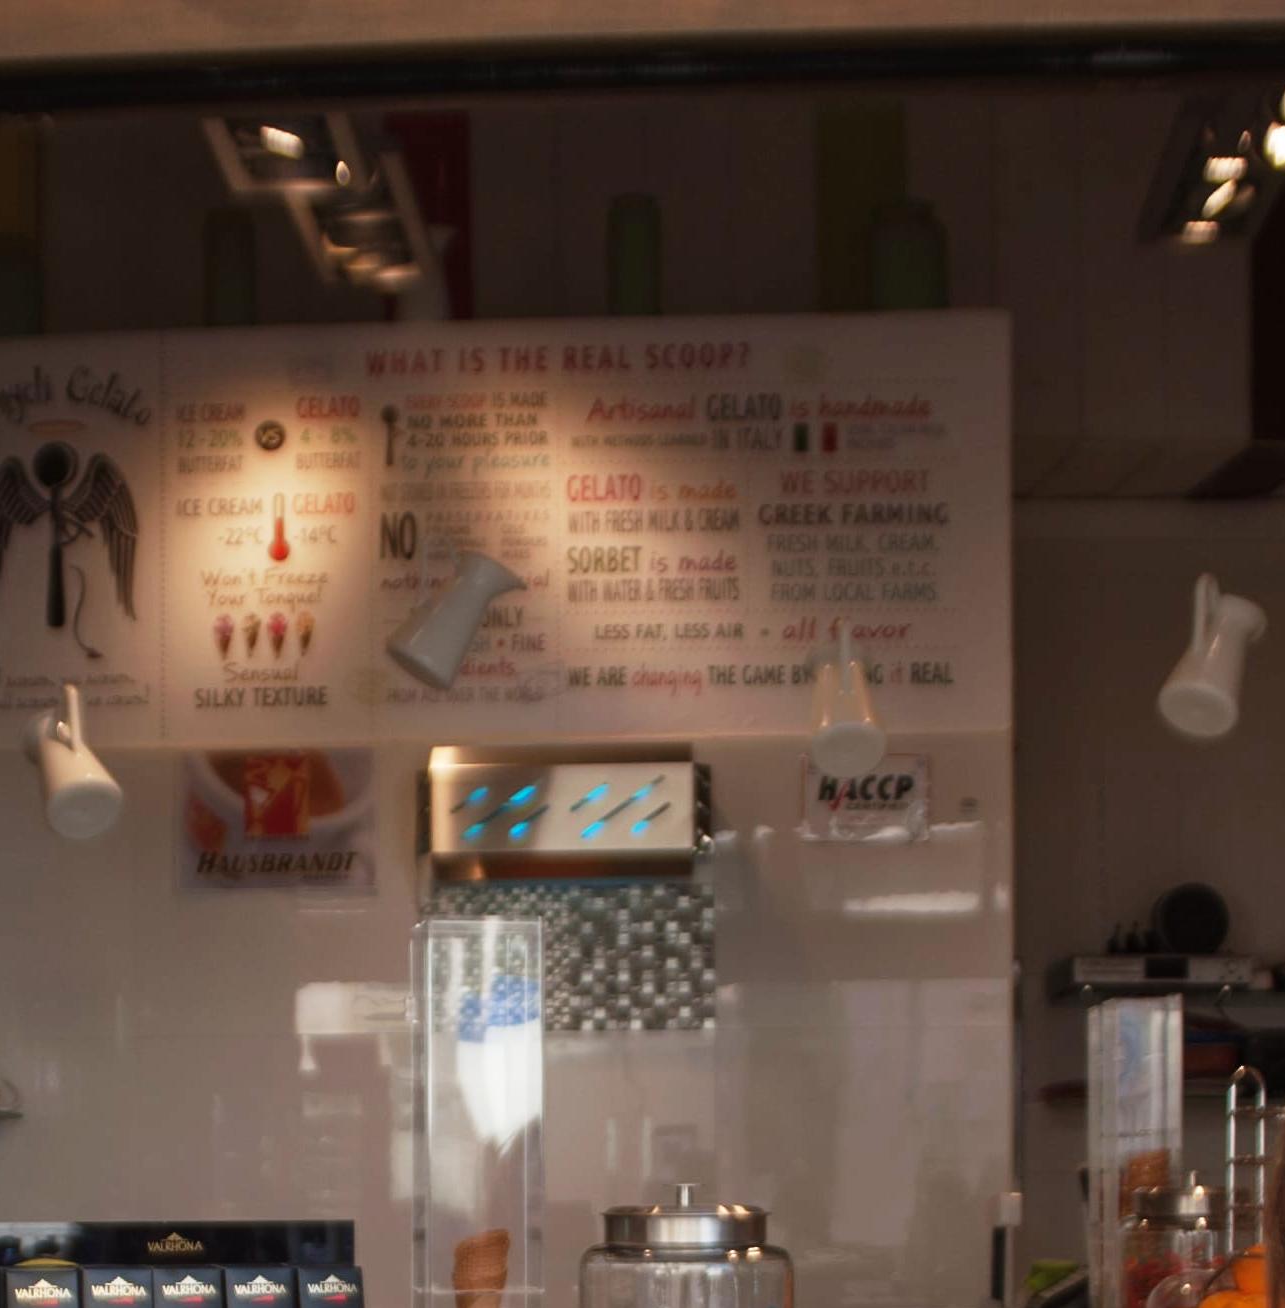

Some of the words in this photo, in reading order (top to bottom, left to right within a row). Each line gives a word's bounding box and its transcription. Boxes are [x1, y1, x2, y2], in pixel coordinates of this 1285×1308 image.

[365, 348, 445, 376] WHAT
[458, 347, 485, 373] IS
[499, 346, 549, 372] THE
[561, 344, 632, 372] REAL
[644, 341, 752, 369] SCOOP?
[296, 395, 361, 418] GELATO
[510, 390, 548, 406] MADE
[587, 395, 696, 421] Artisanal
[706, 393, 783, 421] GELATO
[789, 400, 810, 418] is
[818, 393, 933, 418] handmade
[176, 403, 198, 423] ICE
[202, 402, 245, 422] CREAM
[407, 414, 432, 429] NO
[440, 413, 487, 429] MORE
[495, 413, 537, 427] THAN
[406, 432, 444, 448] 4-20
[451, 431, 498, 447] HOURS
[504, 430, 548, 445] PRIOR
[711, 427, 729, 449] IN
[736, 426, 784, 450] ITALY
[178, 454, 244, 474] BUTTERFAT
[296, 450, 361, 470] BUTTERFAT
[423, 454, 465, 479] your
[471, 450, 551, 476] pleasure
[567, 472, 642, 501] GELATO
[650, 483, 669, 500] is
[678, 480, 738, 500] made
[780, 468, 815, 494] WE
[823, 468, 930, 494] SUPPORT
[176, 498, 202, 517] ICE
[207, 497, 263, 516] CREAM
[291, 492, 356, 515] GELATO
[757, 502, 834, 527] GREEK
[840, 501, 951, 526] FARMING
[568, 511, 600, 533] WITH
[605, 509, 643, 532] FRESH
[648, 508, 679, 531] MILK
[698, 507, 740, 531] CREAM
[380, 510, 418, 561] NO
[767, 533, 818, 552] FRESH
[567, 546, 642, 575] SORBET
[650, 550, 669, 573] is
[678, 548, 738, 571] made
[200, 568, 255, 587] Won't
[263, 566, 329, 586] Freeze
[205, 587, 246, 607] Your
[568, 580, 598, 603] WITH
[602, 579, 641, 602] WATER
[659, 577, 695, 601] FRESH
[699, 576, 740, 601] FRUITS
[771, 583, 816, 602] FROM
[823, 582, 875, 602] LOCAL
[594, 624, 630, 641] LESS
[674, 623, 711, 640] LESS
[715, 621, 744, 639] AIR
[782, 615, 816, 641] all
[828, 615, 913, 641] favor
[511, 634, 546, 652] FINE
[222, 662, 300, 682] Sensual
[568, 665, 591, 688] WE
[596, 664, 627, 687] ARE
[631, 668, 702, 697] changing
[708, 664, 736, 686] THE
[742, 663, 785, 686] GAME
[910, 661, 955, 686] REAL
[195, 687, 246, 709] SILKY
[253, 684, 329, 708] TEXTURE
[818, 774, 915, 802] HACCP
[196, 851, 358, 879] HAUSBRANDT
[147, 1239, 204, 1252] VALRHONA
[14, 1287, 73, 1299] VALRHONA
[91, 1284, 147, 1297] VALRHONA
[162, 1284, 216, 1296] VALRHONA
[234, 1283, 286, 1296] VALRHONA
[307, 1283, 357, 1295] VALRHONA
